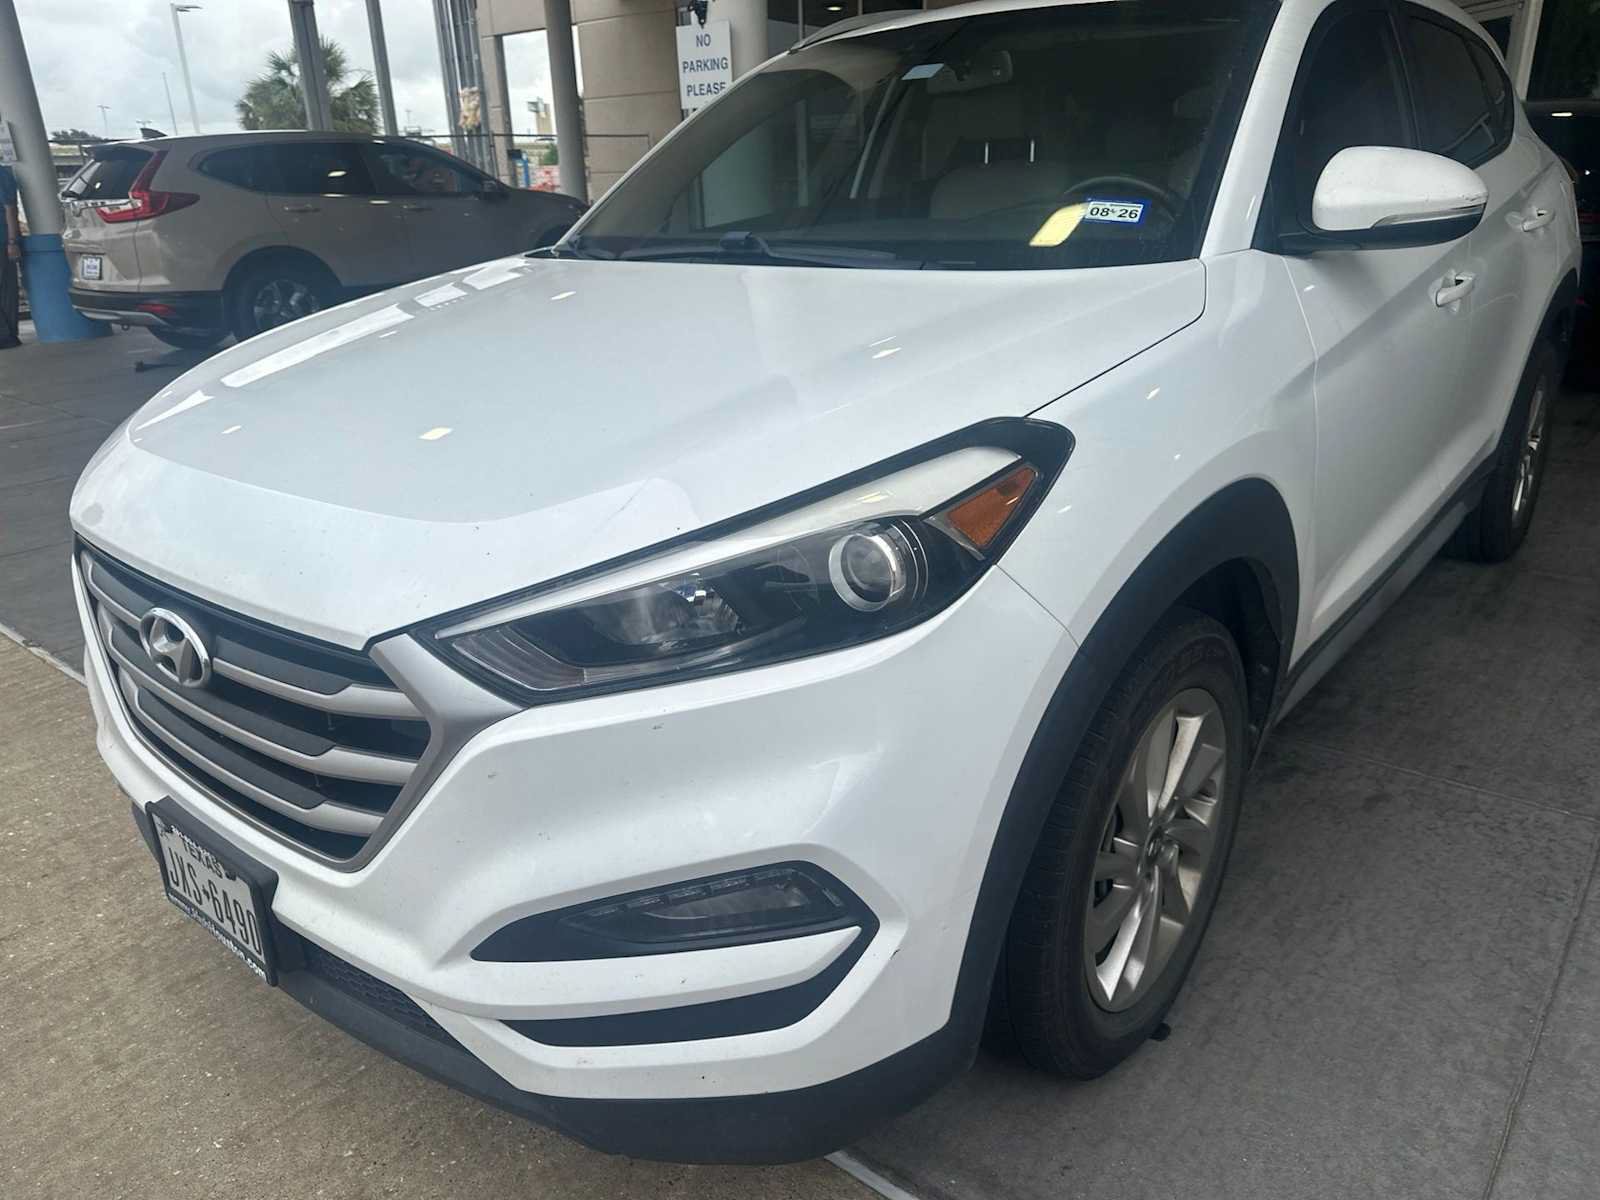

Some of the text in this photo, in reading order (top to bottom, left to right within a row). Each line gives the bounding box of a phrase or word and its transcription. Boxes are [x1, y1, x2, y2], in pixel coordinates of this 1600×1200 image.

[696, 34, 711, 47] NO
[682, 57, 728, 73] PARKING
[1090, 207, 1139, 219] 08 26
[183, 840, 223, 879] TEXAS
